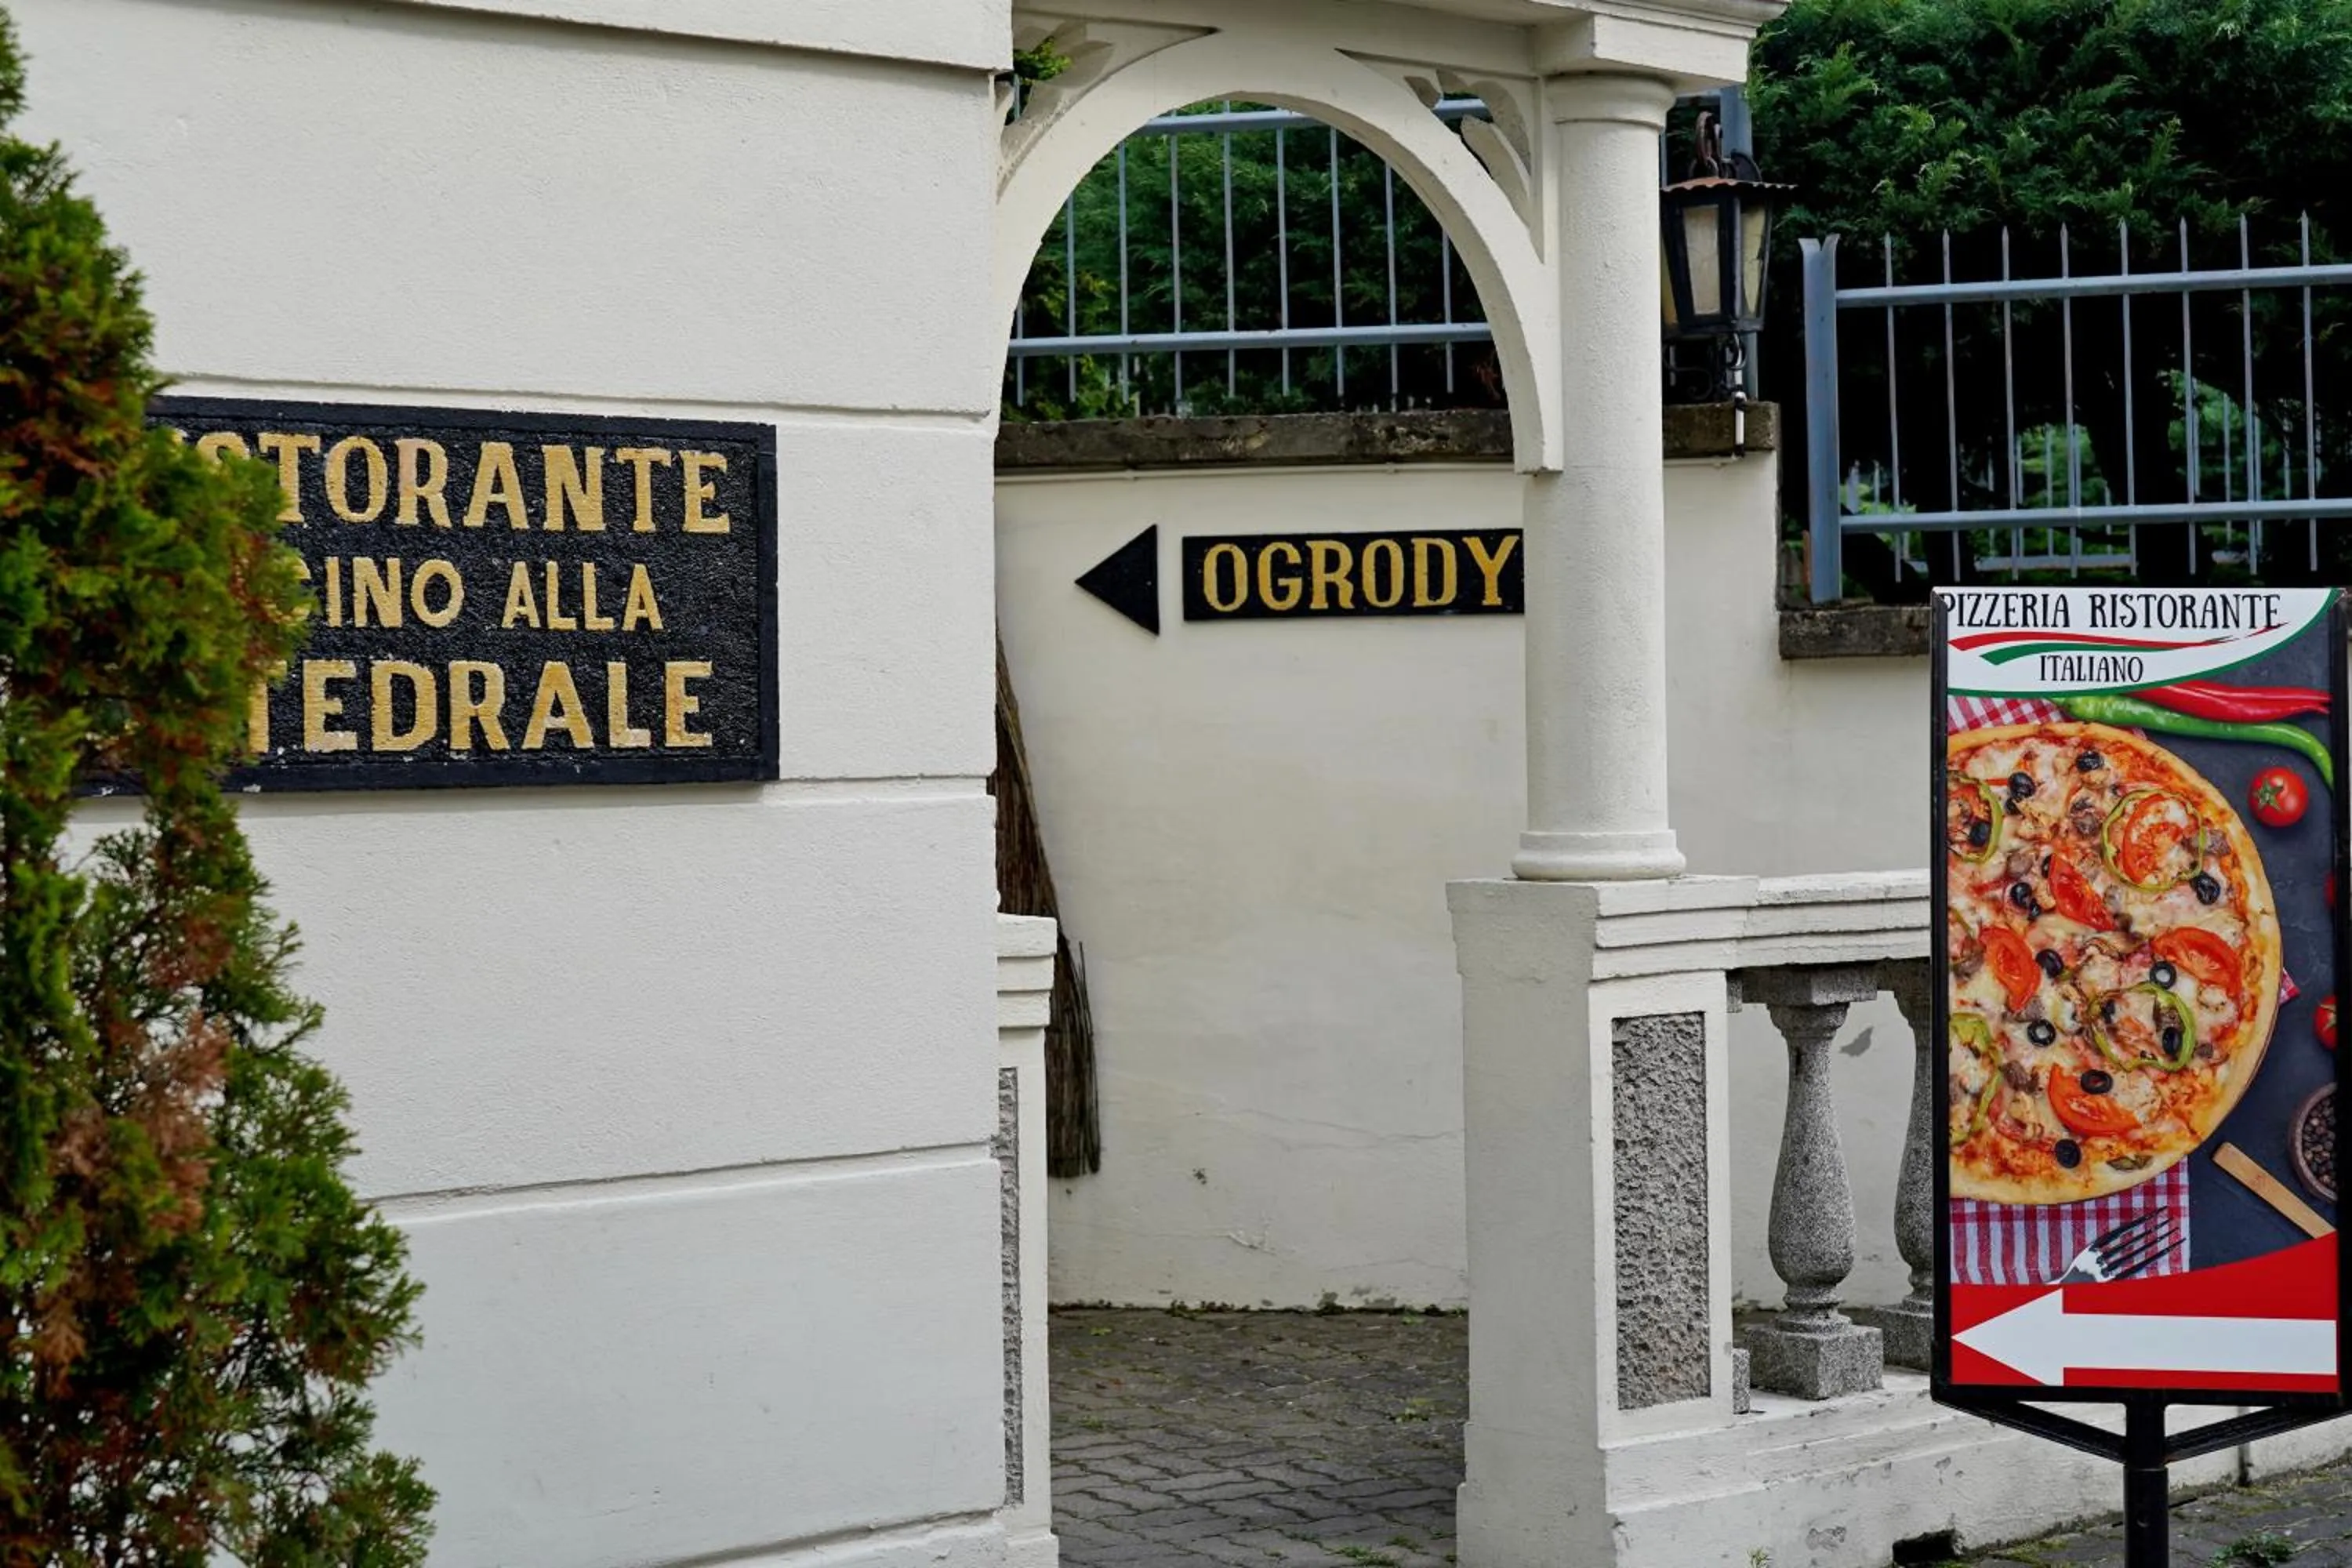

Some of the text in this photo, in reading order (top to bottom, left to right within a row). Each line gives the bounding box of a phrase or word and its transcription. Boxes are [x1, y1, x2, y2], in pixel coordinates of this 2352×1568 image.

[172, 428, 732, 535] TORANTE
[501, 559, 664, 631] ALLA
[1202, 535, 1520, 612] OGRODY
[1939, 593, 2281, 630] PIZZERIA RISTORANTE
[2040, 655, 2143, 684] ITALIANO
